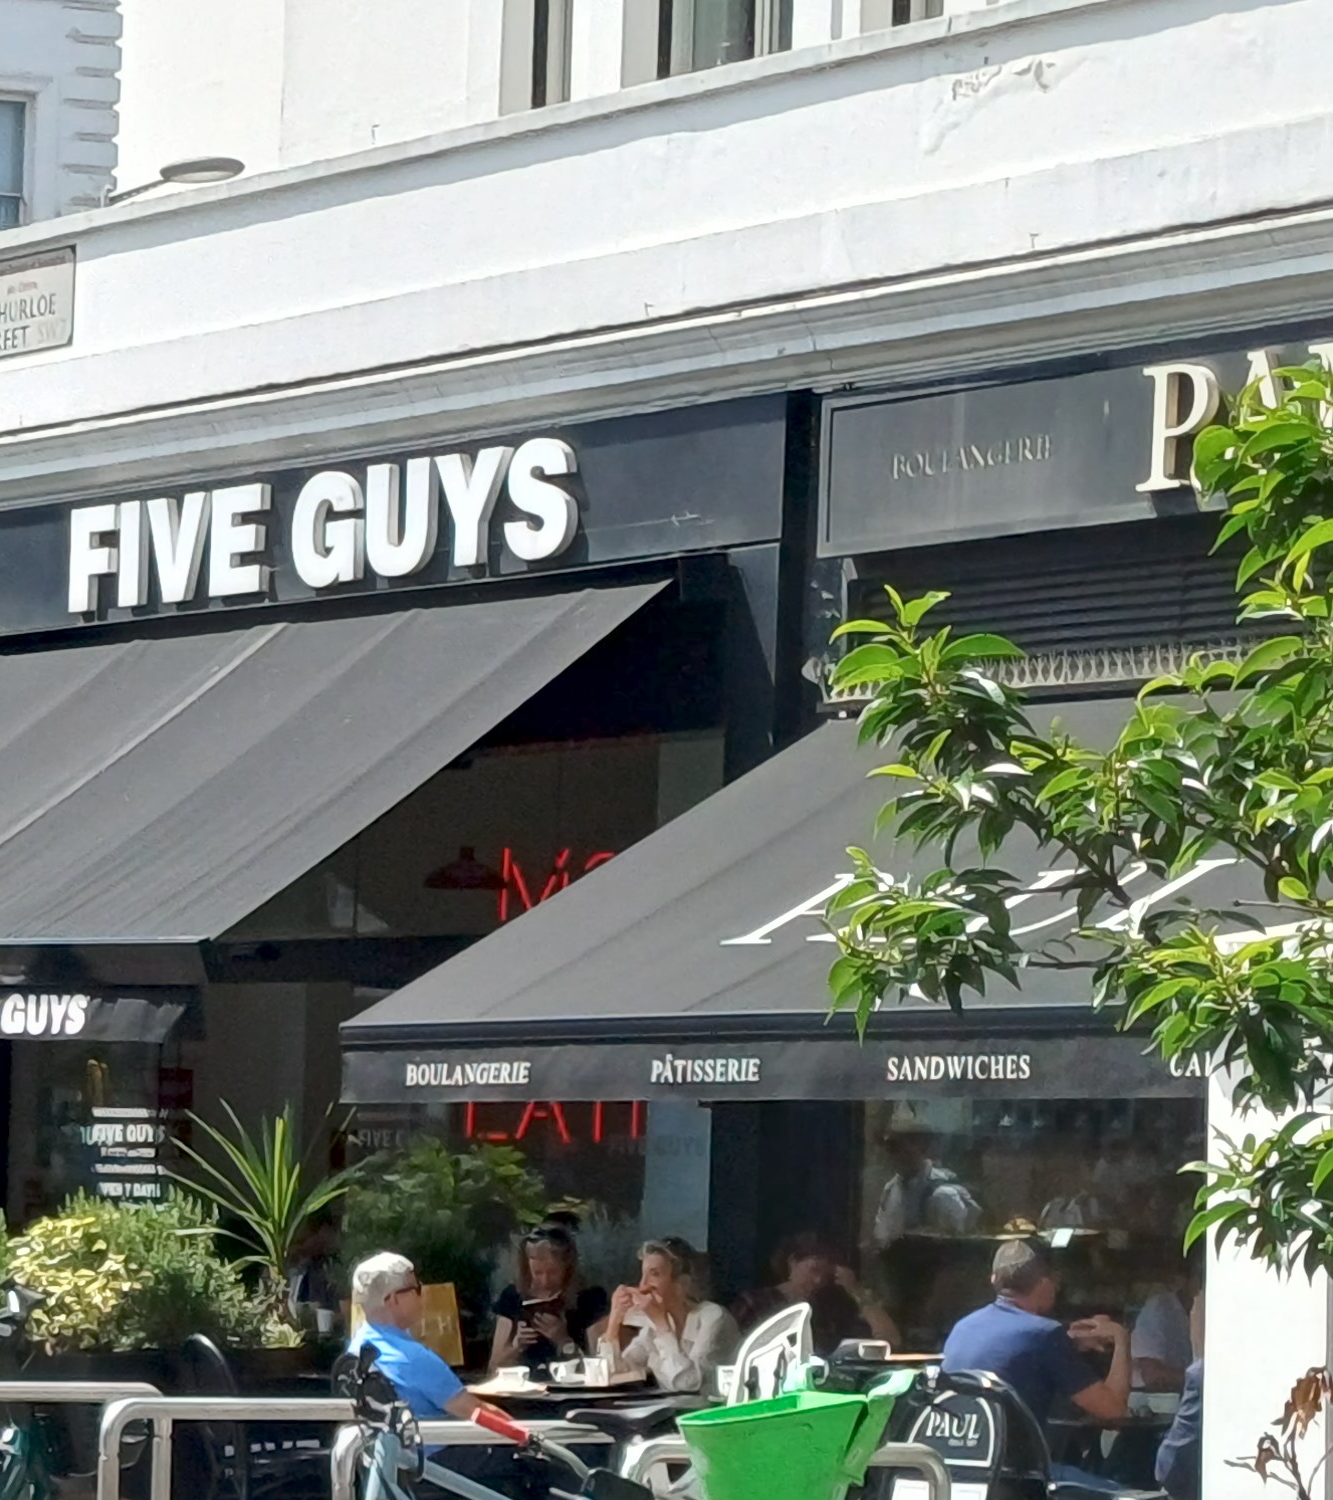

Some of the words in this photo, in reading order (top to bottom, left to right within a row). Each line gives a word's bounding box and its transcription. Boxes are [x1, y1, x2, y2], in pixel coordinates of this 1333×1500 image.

[36, 318, 67, 343] SW7
[893, 434, 1051, 480] BOULANGERIE
[68, 483, 272, 613] FIVE
[292, 437, 578, 588] GUYS
[0, 993, 90, 1035] GUYS
[405, 1061, 531, 1087] BOULANGERIE
[650, 1053, 761, 1084] PÂTISSERIE
[886, 1054, 1031, 1082] SANDWICHES
[926, 1411, 980, 1440] PAUL
